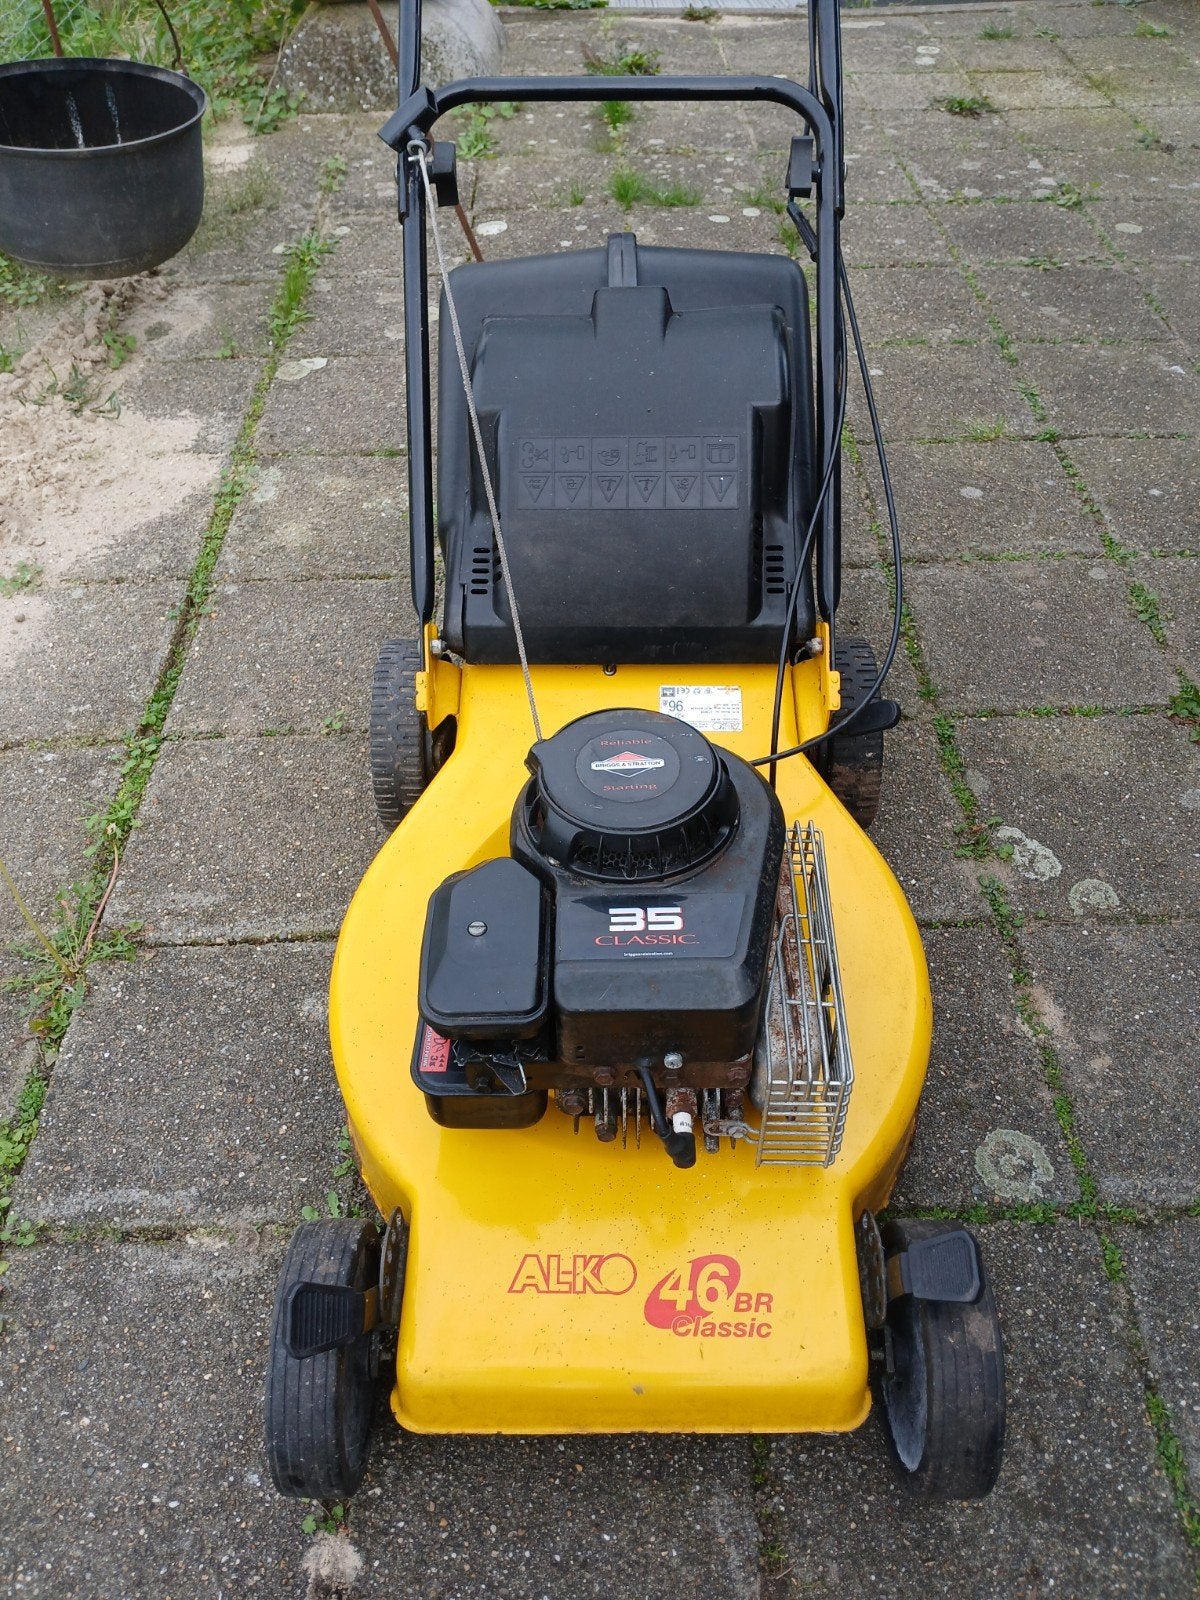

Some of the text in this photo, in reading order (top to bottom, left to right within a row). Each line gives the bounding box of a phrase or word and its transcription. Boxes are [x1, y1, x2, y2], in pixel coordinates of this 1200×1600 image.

[668, 700, 684, 712] 96
[603, 783, 657, 791] Starting
[609, 907, 683, 932] 35
[507, 1253, 637, 1295] AL-KO
[659, 1261, 773, 1313] 46 BR
[672, 1315, 772, 1338] Classic
